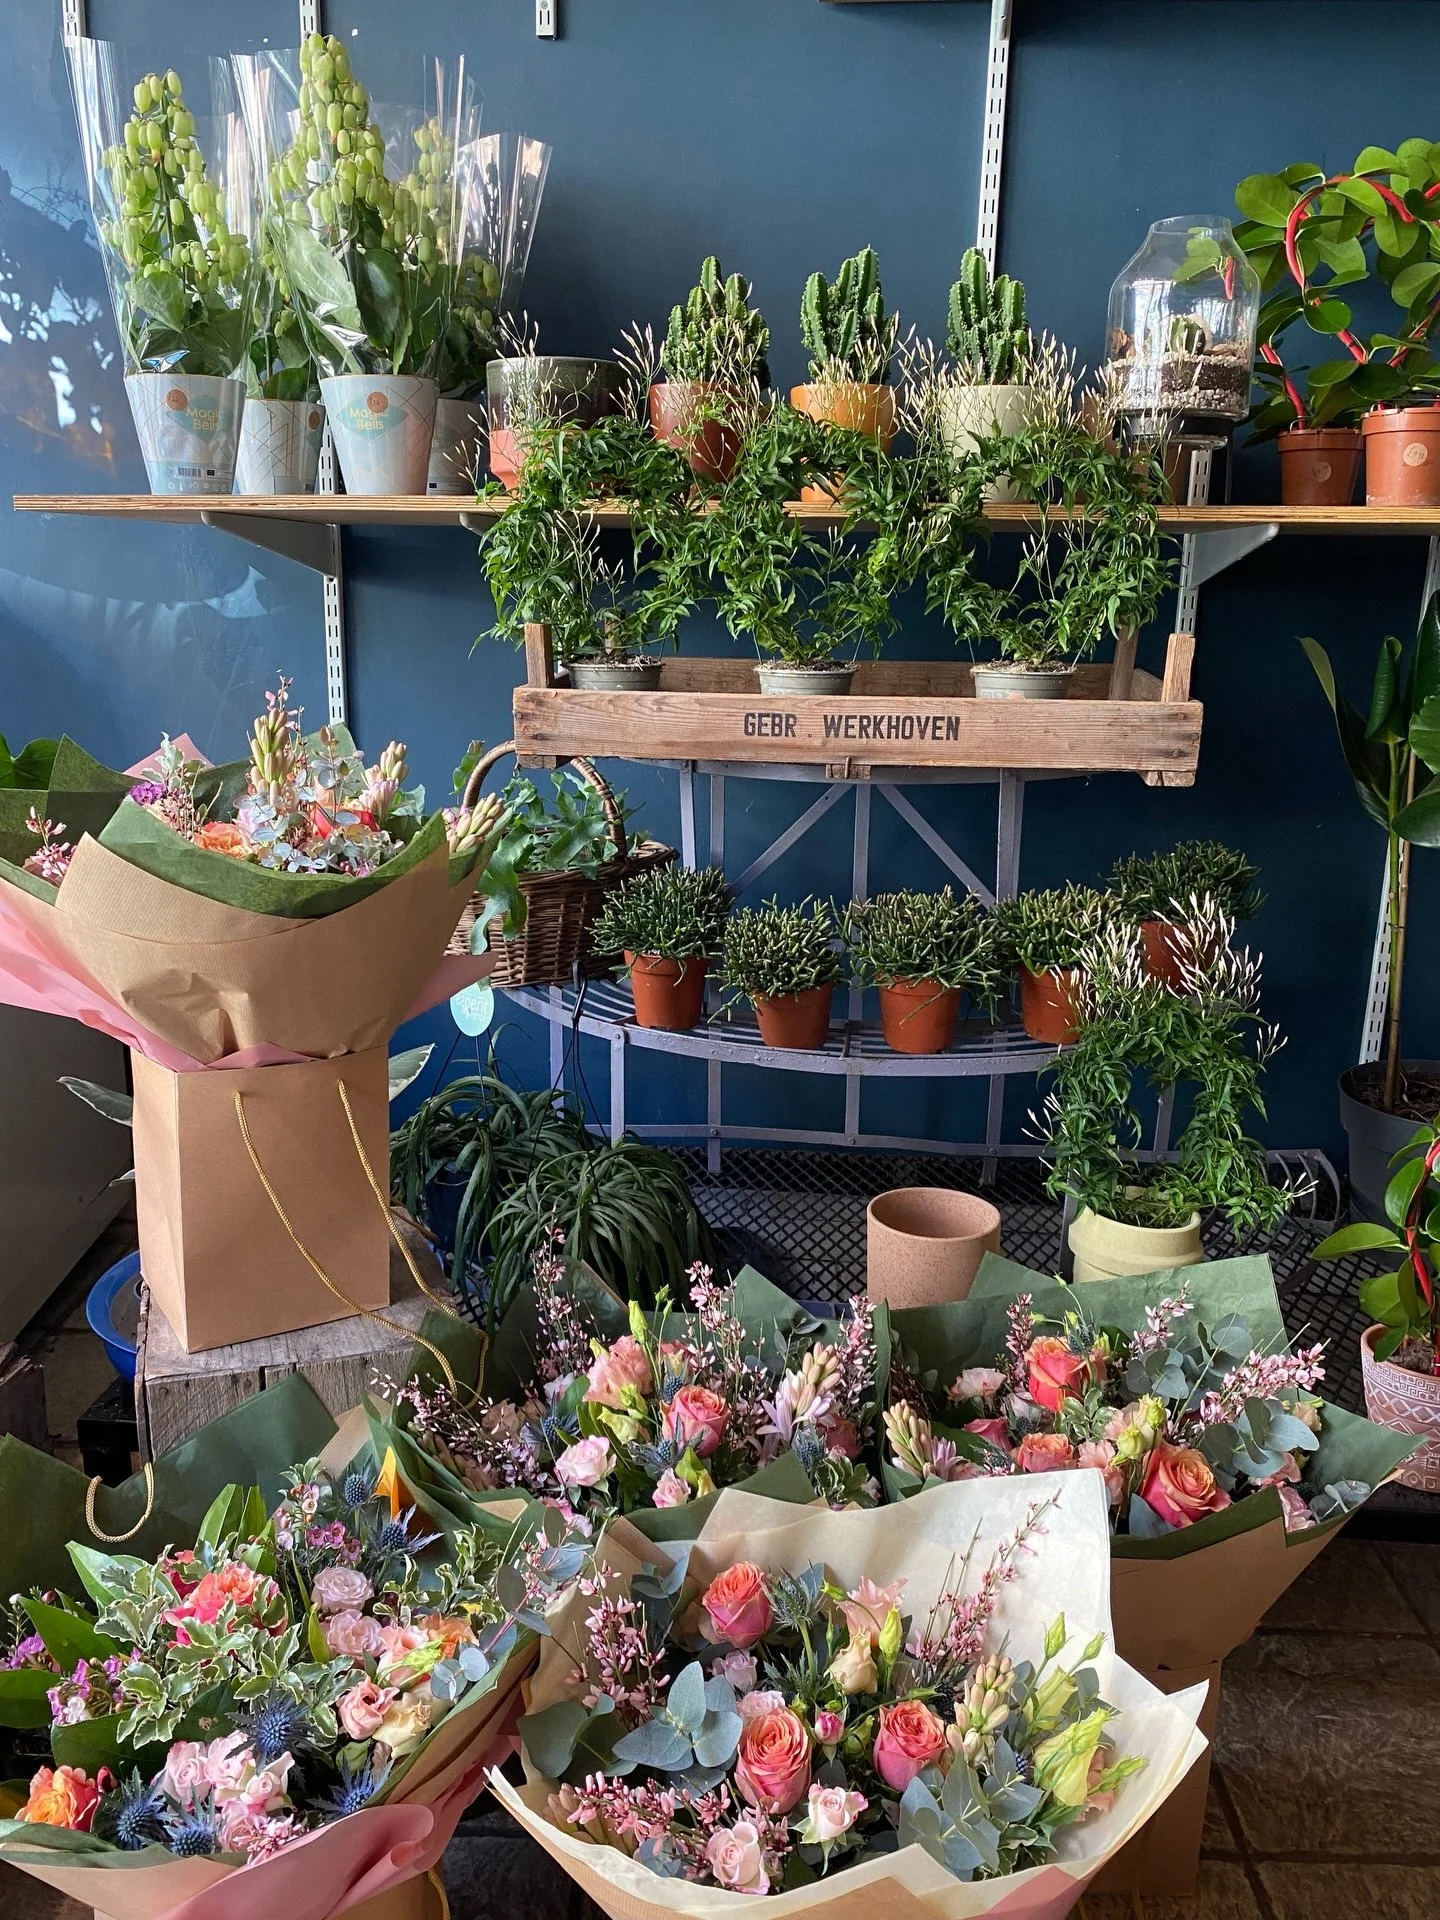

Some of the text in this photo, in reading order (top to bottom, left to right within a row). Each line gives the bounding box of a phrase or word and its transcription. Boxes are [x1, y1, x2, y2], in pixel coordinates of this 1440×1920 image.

[192, 419, 220, 431] Bells
[356, 419, 384, 431] Bells
[823, 714, 960, 741] WERKHOVEN
